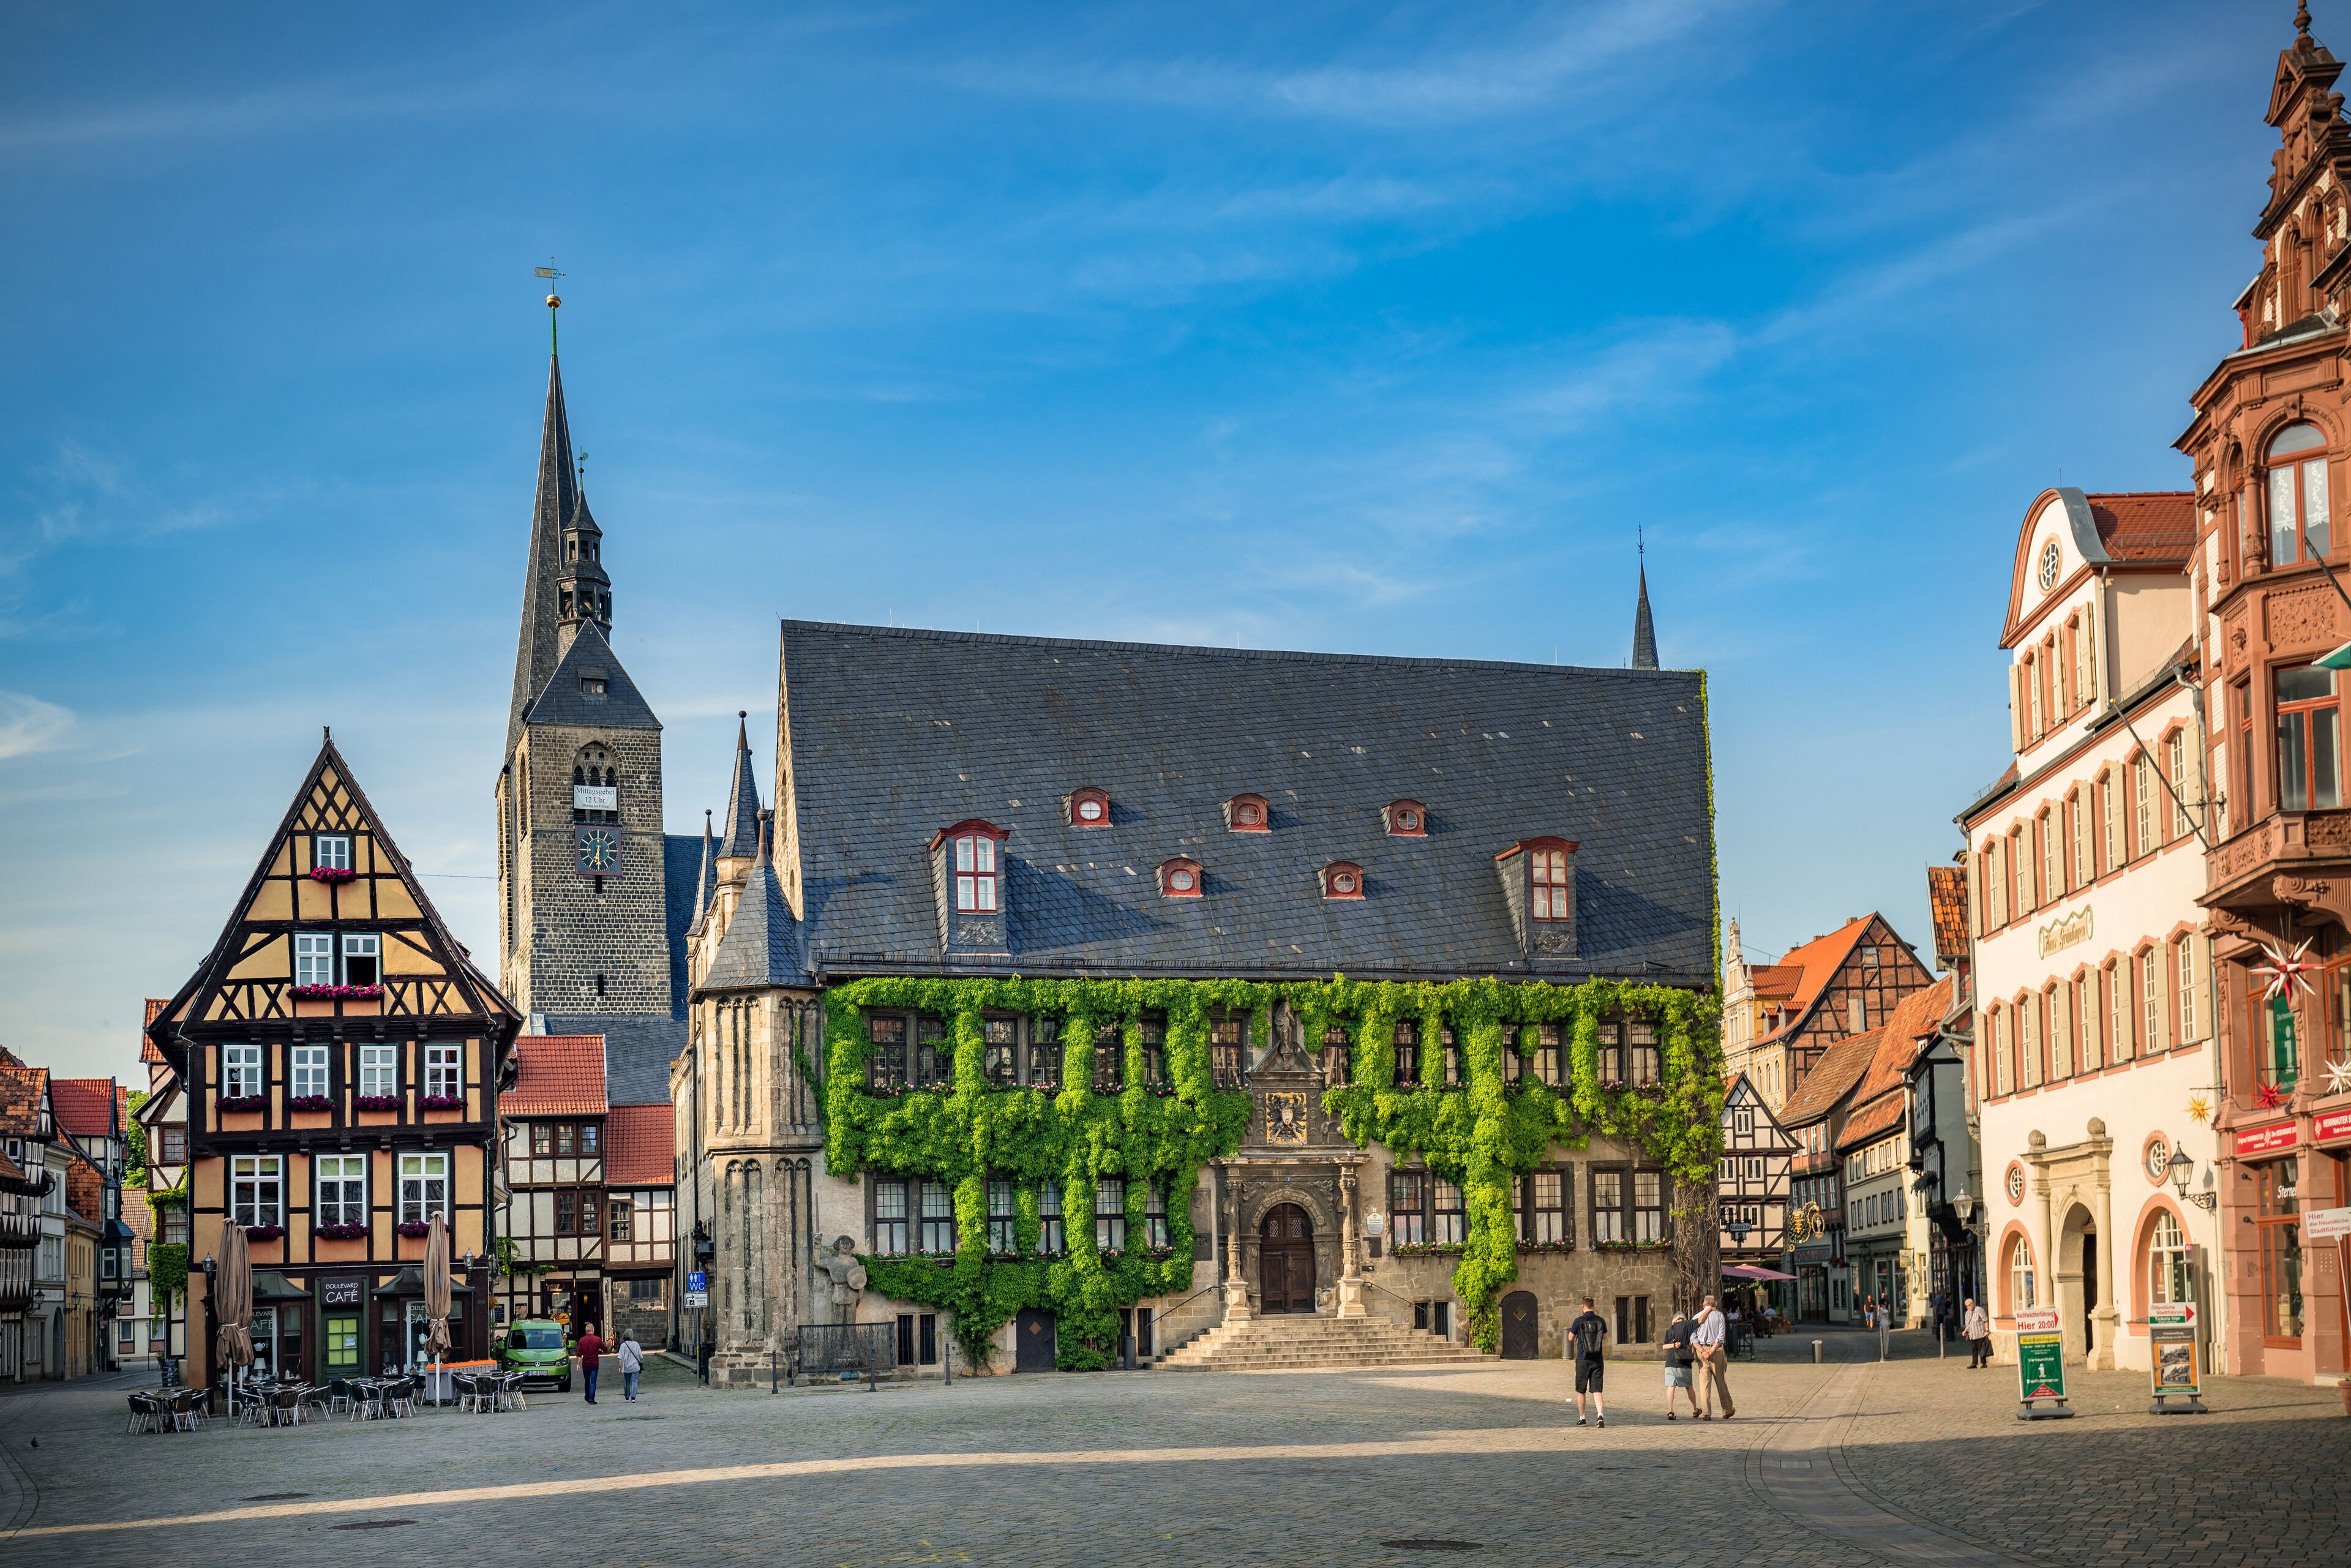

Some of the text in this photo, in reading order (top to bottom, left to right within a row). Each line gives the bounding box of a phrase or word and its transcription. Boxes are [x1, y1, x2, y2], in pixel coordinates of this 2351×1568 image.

[576, 787, 615, 796] Mittagsgebet
[2045, 934, 2057, 953] Haus
[2310, 1225, 2350, 1234] Stadtführung
[689, 1282, 705, 1291] WC
[326, 1288, 358, 1303] CAFÉ
[250, 1316, 275, 1330] AFÉ
[405, 1313, 430, 1324] CAF
[2017, 1320, 2055, 1330] Hier 20:00
